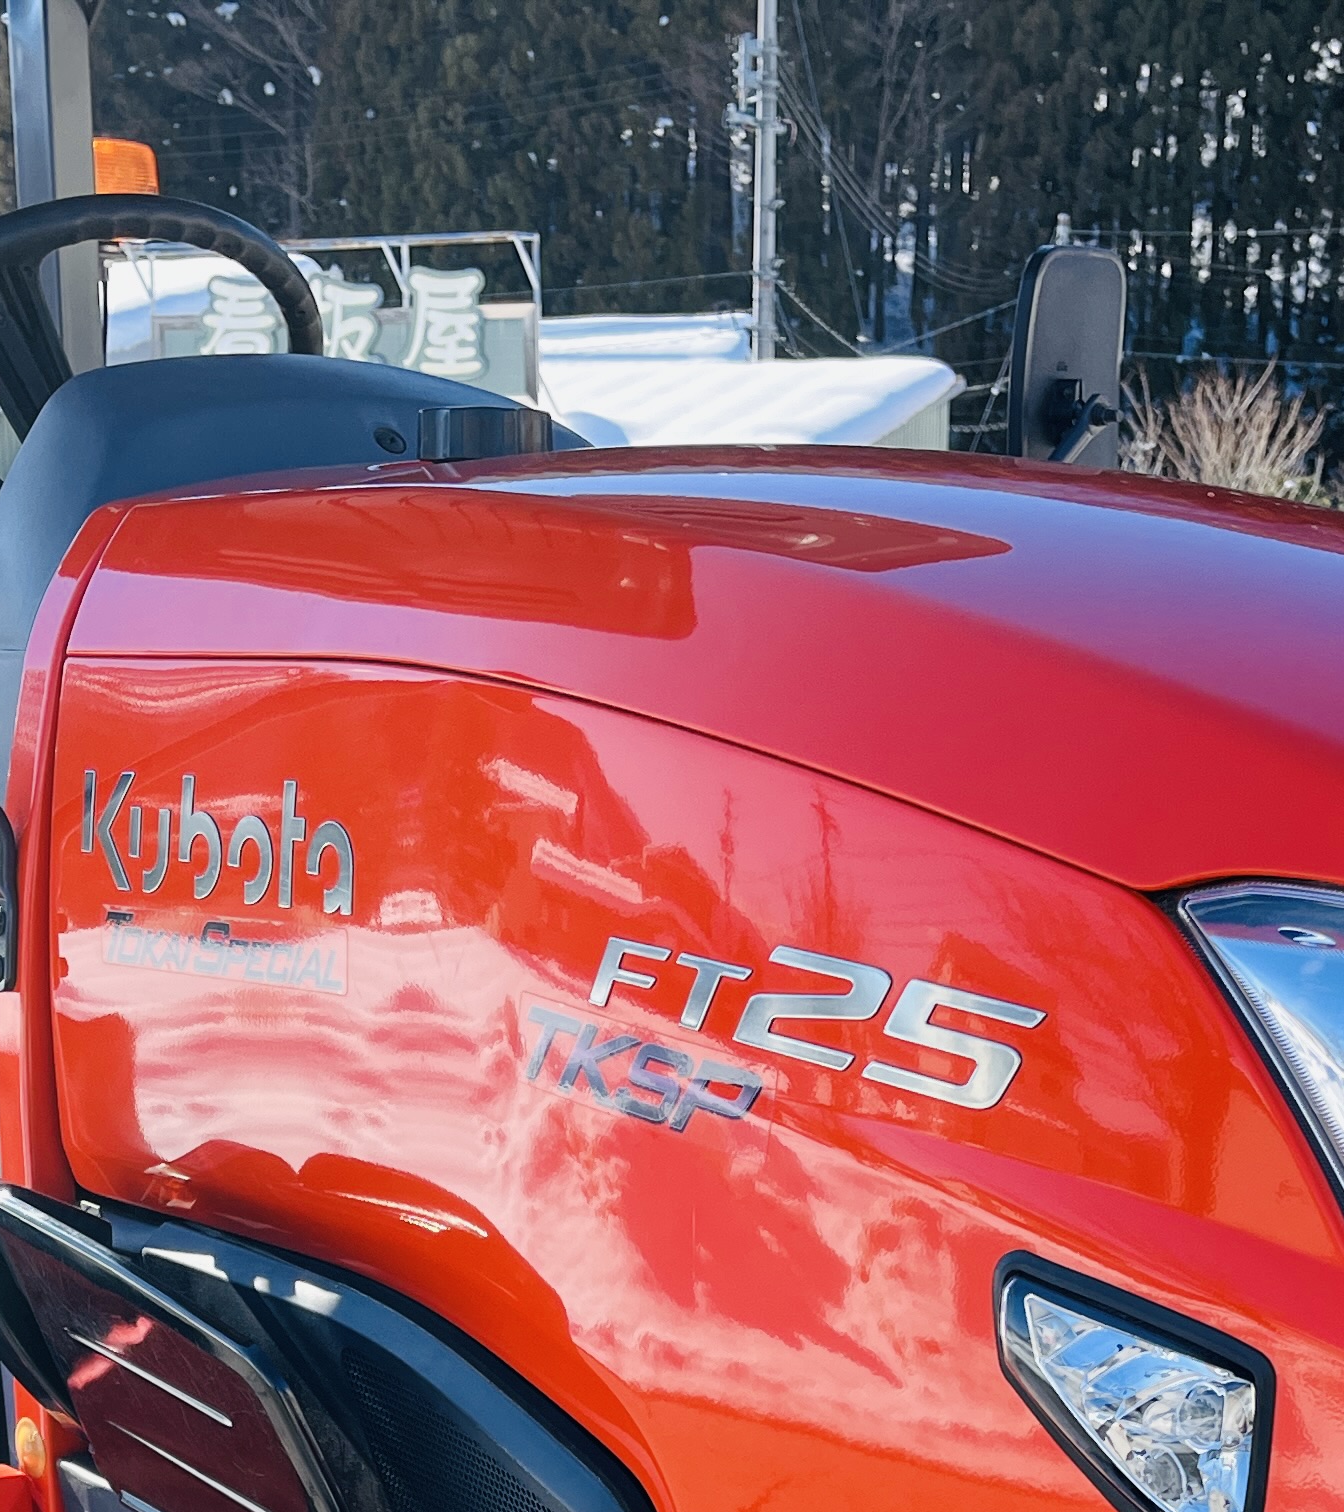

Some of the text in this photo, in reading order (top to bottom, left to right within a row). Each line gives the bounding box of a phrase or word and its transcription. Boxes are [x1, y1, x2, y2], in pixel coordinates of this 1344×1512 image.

[81, 769, 354, 916] Kubota
[193, 920, 344, 991] SPECIAL
[588, 936, 1048, 1110] FT25
[526, 1005, 763, 1132] TKSP
